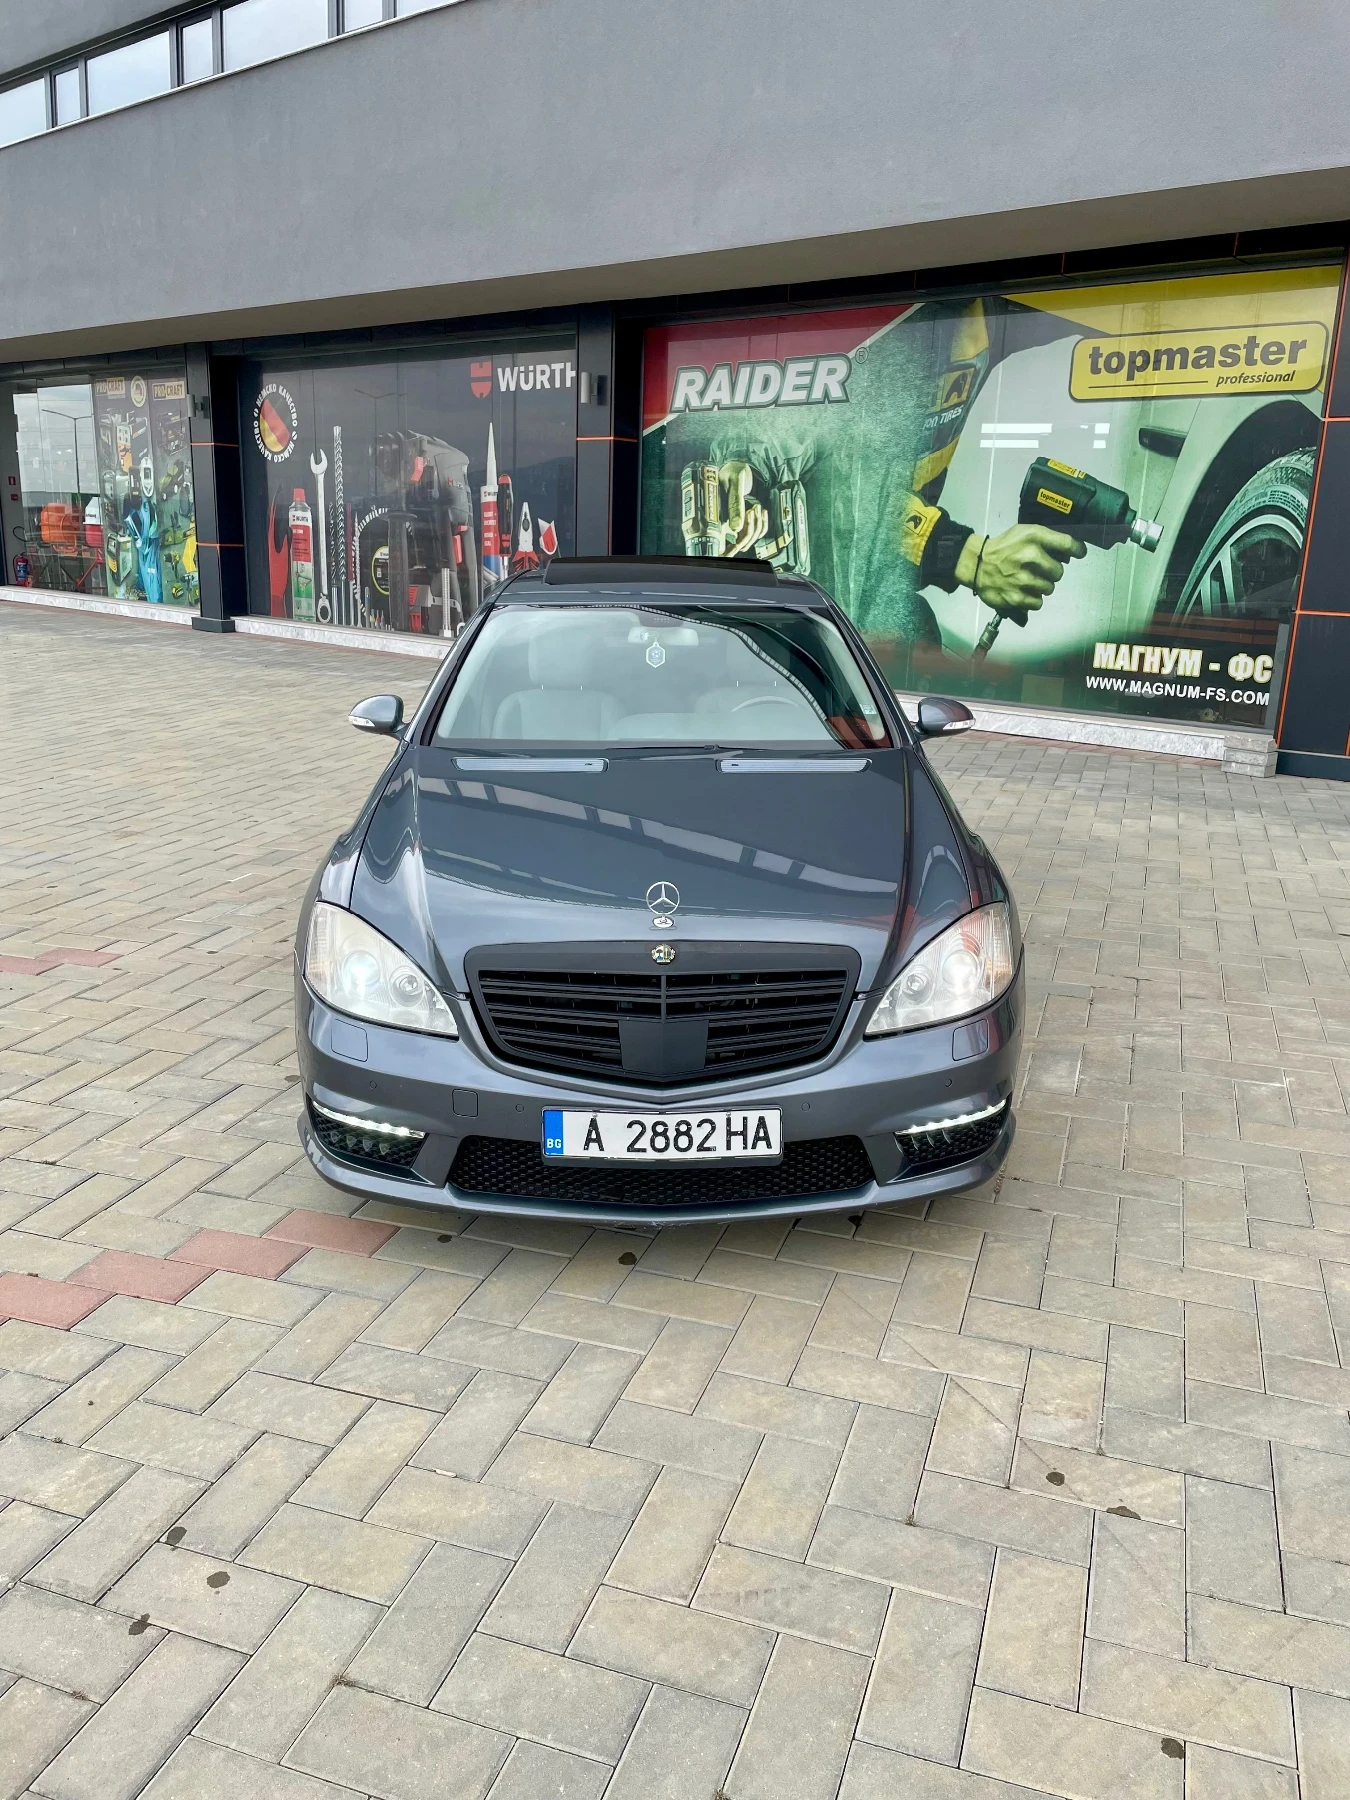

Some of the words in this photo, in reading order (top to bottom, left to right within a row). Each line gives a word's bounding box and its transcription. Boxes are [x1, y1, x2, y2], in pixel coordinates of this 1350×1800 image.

[1089, 336, 1307, 381] topmaster
[497, 362, 577, 392] WÜRTH
[672, 355, 850, 411] RAIDER
[1216, 370, 1296, 387] professional
[256, 383, 277, 408] НЕМСКО
[278, 384, 298, 427] КАЧЕСТВО
[253, 420, 273, 461] КАЧЕСТВО
[273, 440, 295, 463] НЕМСКО
[1040, 491, 1071, 509] topmaster
[1093, 642, 1203, 678] МАГНУМ
[1227, 652, 1274, 684] ФС
[1086, 675, 1270, 706] WWW.MAGNUM-FS.COM
[546, 1139, 562, 1149] BG
[583, 1117, 605, 1151] A
